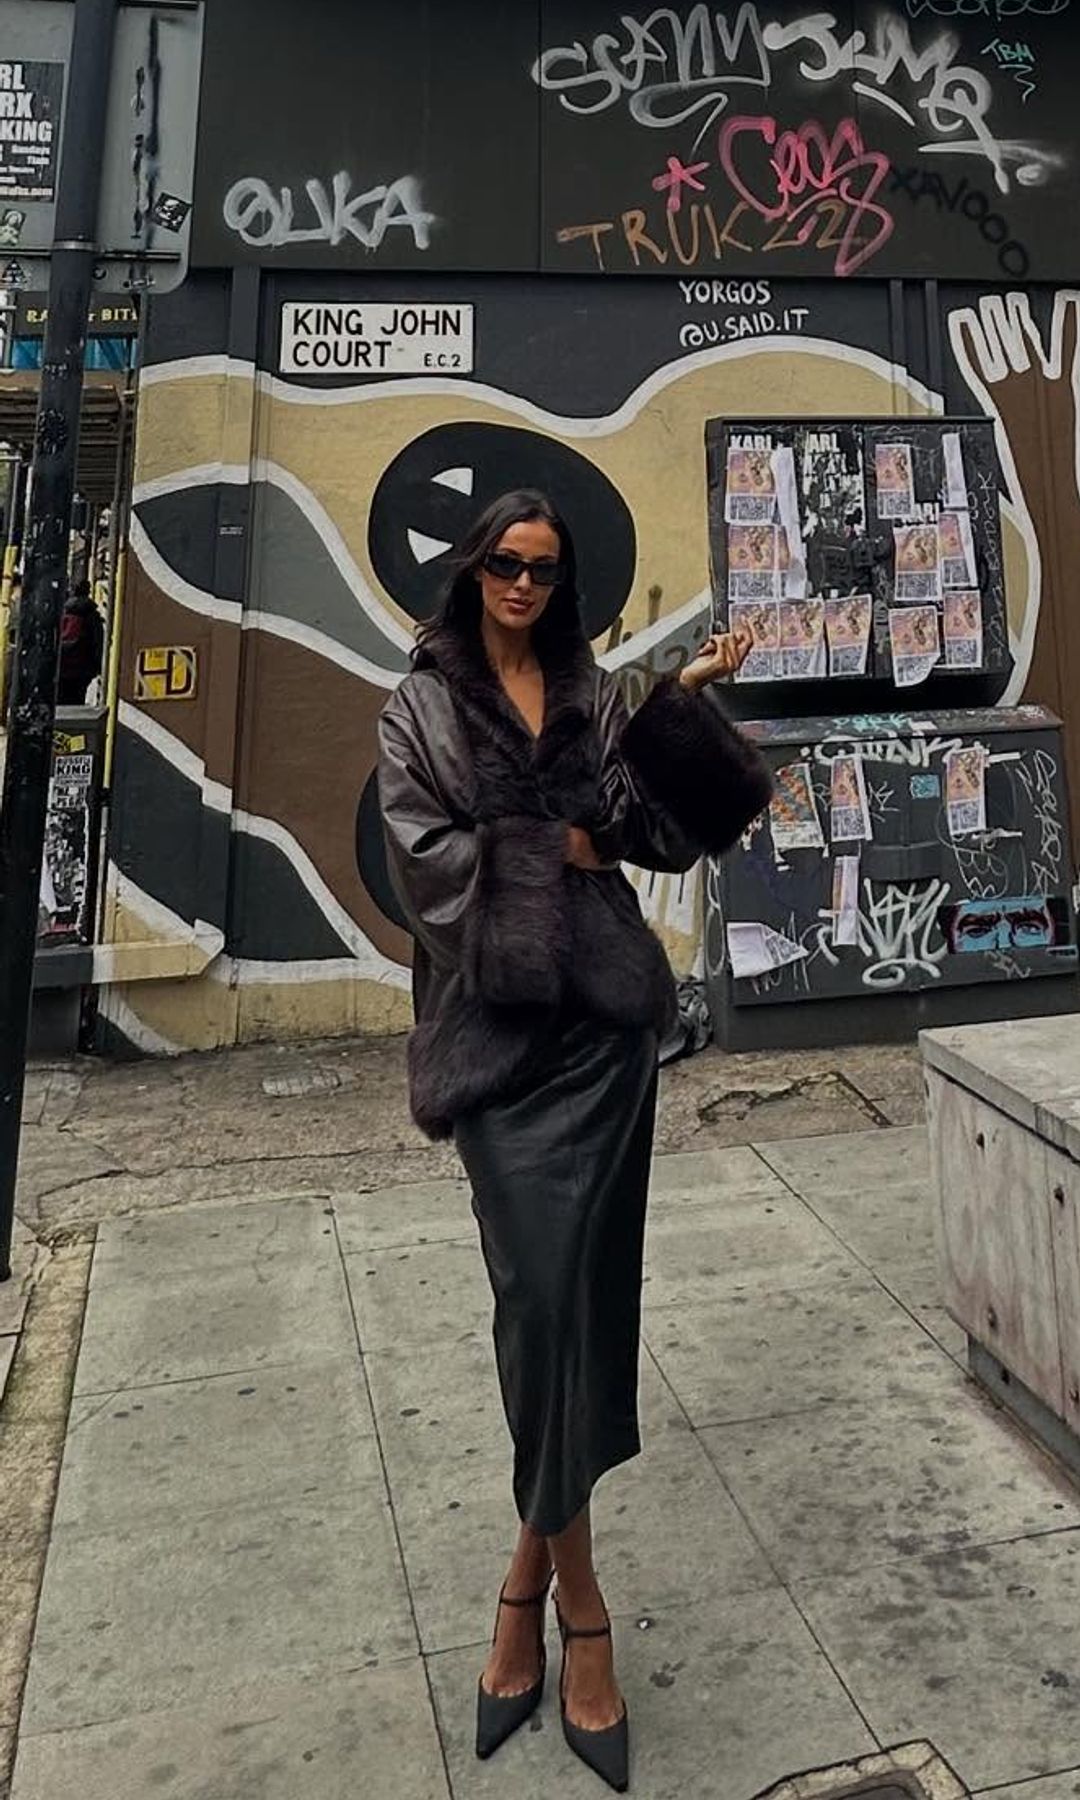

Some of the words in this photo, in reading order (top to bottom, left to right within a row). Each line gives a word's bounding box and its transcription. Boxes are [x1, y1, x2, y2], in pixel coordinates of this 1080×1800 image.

[678, 280, 771, 305] YORGOS
[293, 308, 363, 335] KING
[380, 309, 461, 336] JOHN
[679, 308, 809, 347] @U.SAID.IT
[292, 341, 392, 367] COURT
[56, 765, 91, 775] KING
